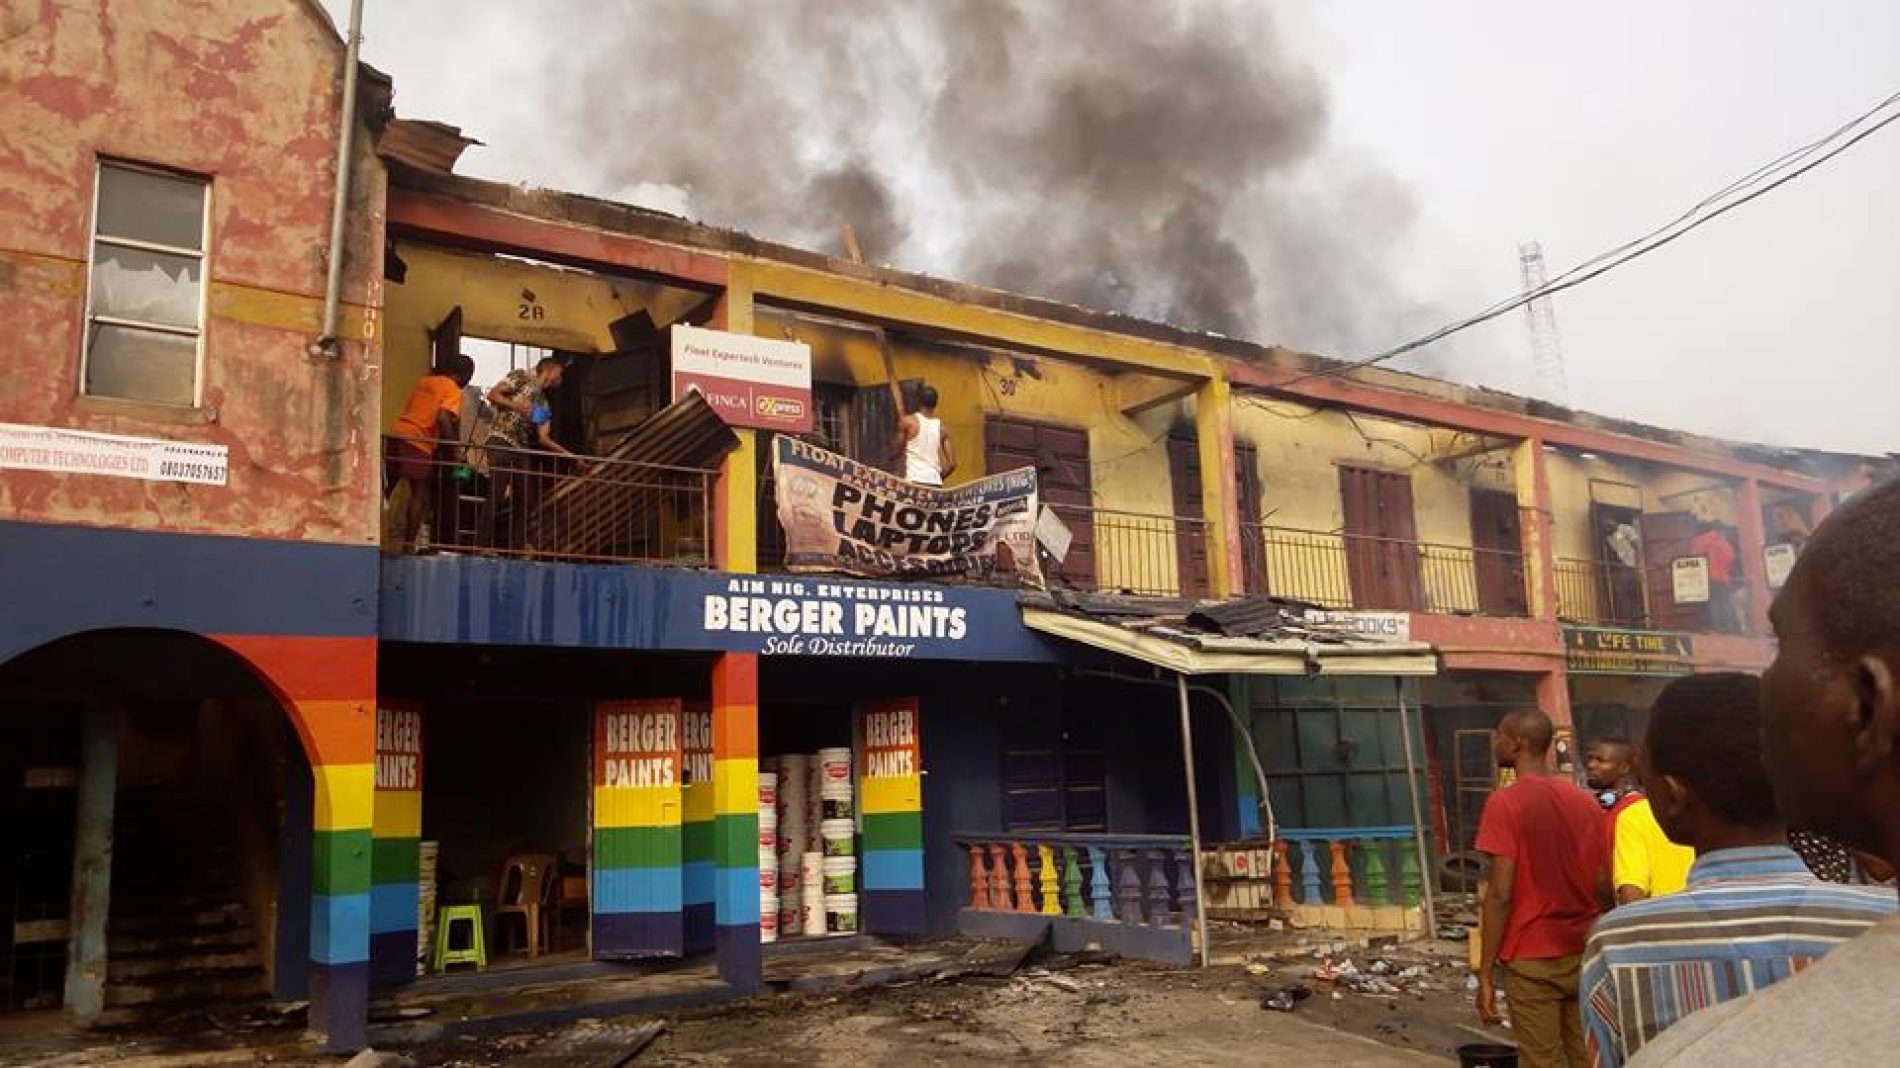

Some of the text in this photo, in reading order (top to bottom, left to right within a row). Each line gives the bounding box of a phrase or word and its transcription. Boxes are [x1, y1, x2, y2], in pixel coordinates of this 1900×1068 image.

[0, 446, 49, 465] OMPUTER
[833, 482, 990, 533] PHONES
[833, 509, 988, 558] LAPTOPS
[727, 579, 943, 602] AIM NIG. ENTERPRISES
[704, 594, 967, 640] BERGER PAINTS
[762, 635, 914, 657] Sole Distributor
[377, 709, 420, 752] ERGER
[606, 713, 676, 753] BERGER
[683, 711, 712, 749] ERG
[866, 711, 914, 747] BERGER
[376, 754, 417, 789] AINTS
[605, 757, 674, 788] PAINTS
[867, 750, 913, 779] PAINTS
